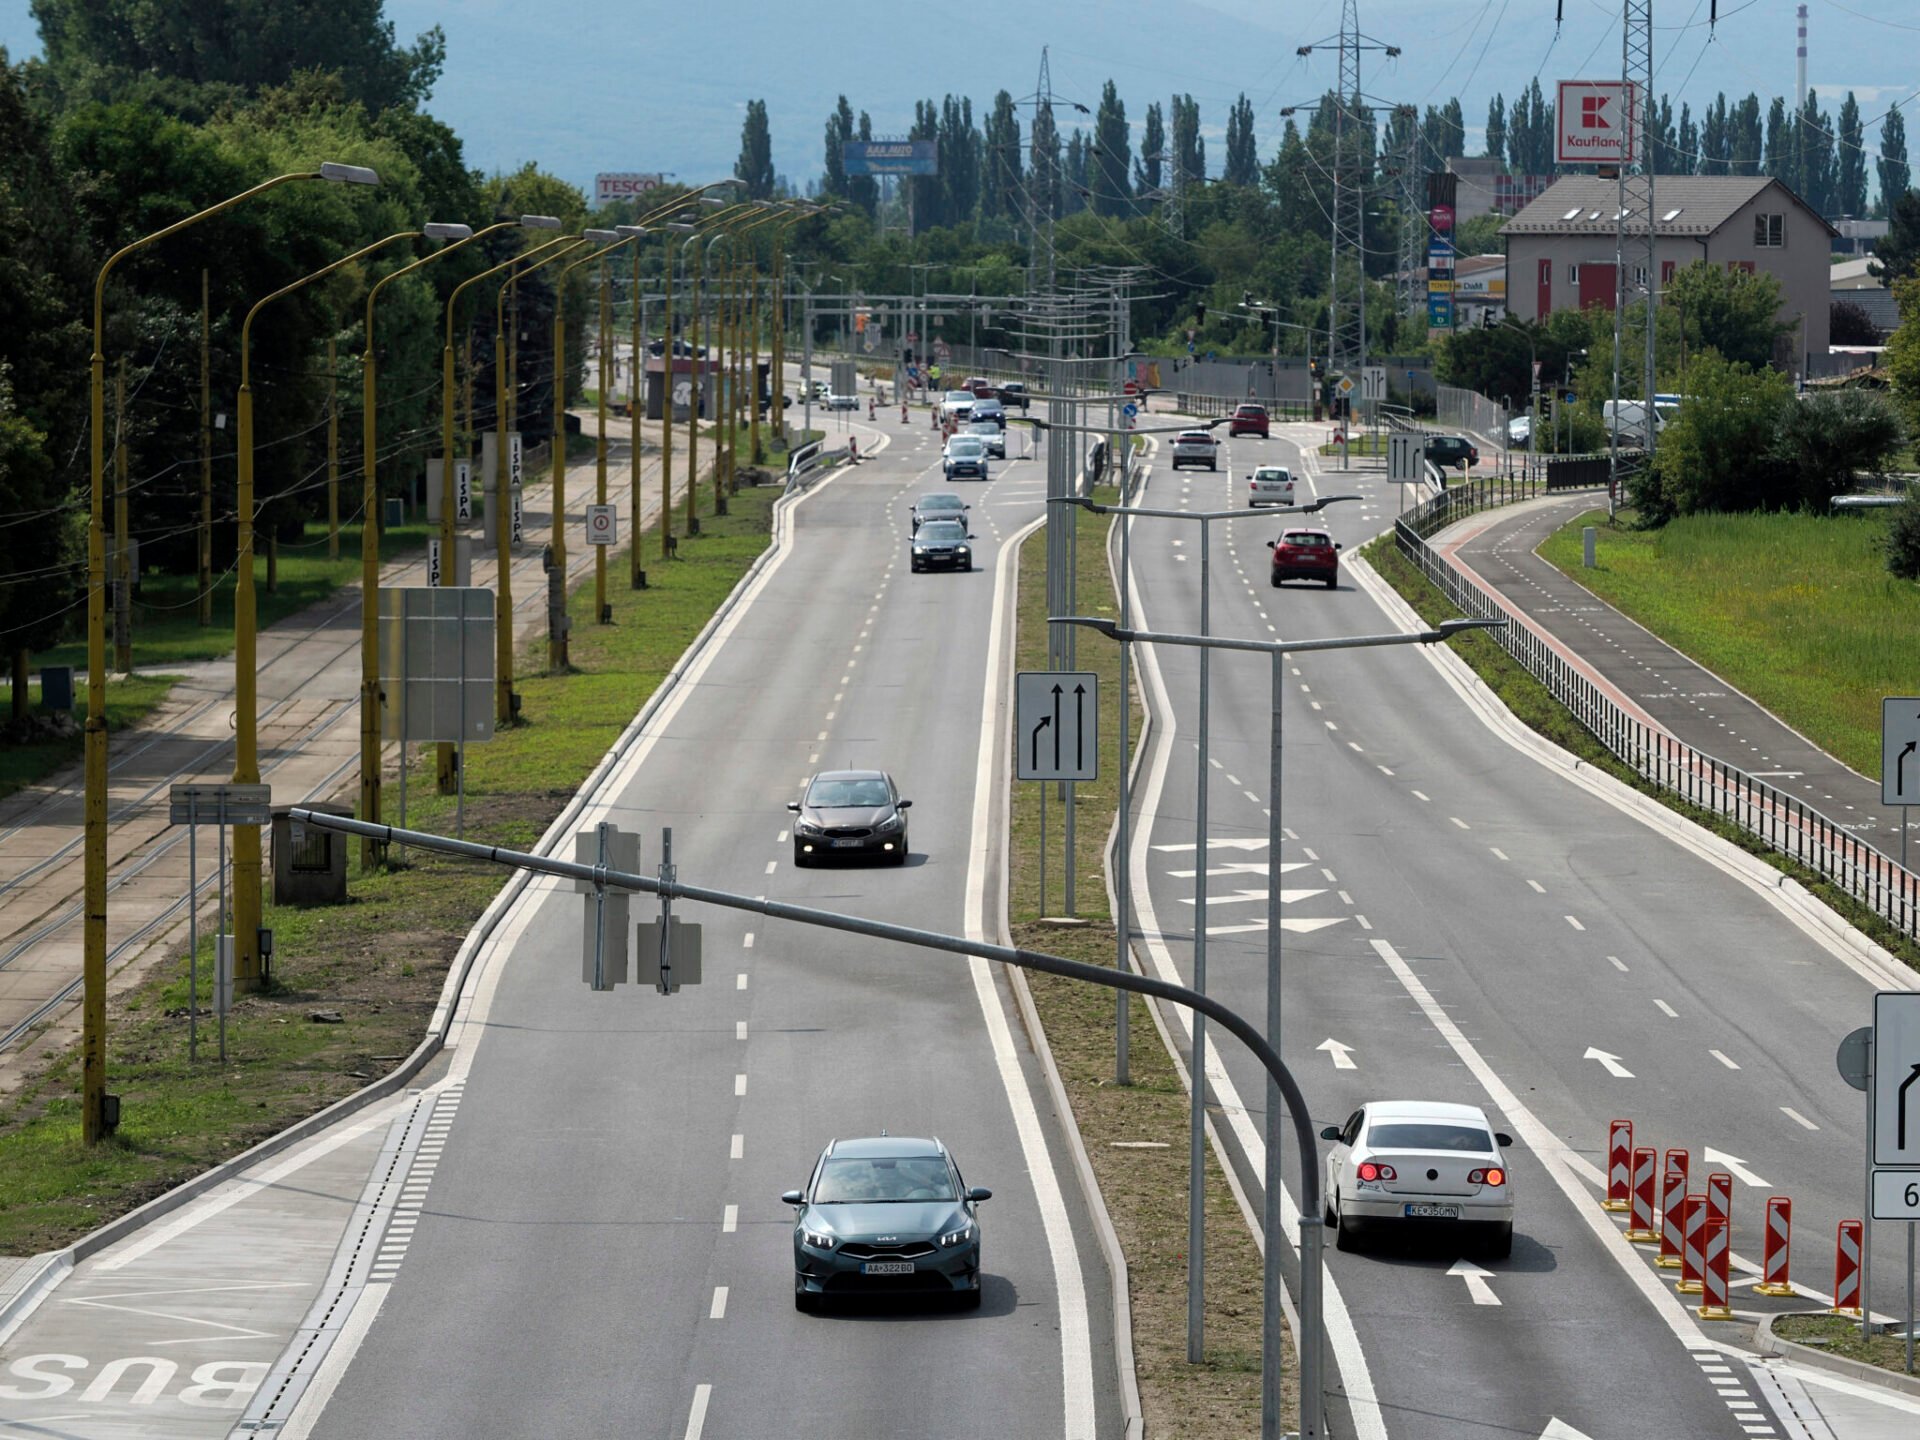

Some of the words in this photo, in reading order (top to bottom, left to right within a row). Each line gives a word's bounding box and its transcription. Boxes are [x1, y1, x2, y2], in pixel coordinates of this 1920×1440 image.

[599, 180, 657, 193] TESCO
[511, 442, 520, 484] ISPA
[459, 471, 469, 518] ISPA
[512, 501, 521, 543] ISPA
[431, 545, 440, 586] ISP
[1904, 1182, 1919, 1207] 6
[0, 1353, 273, 1409] BUS
